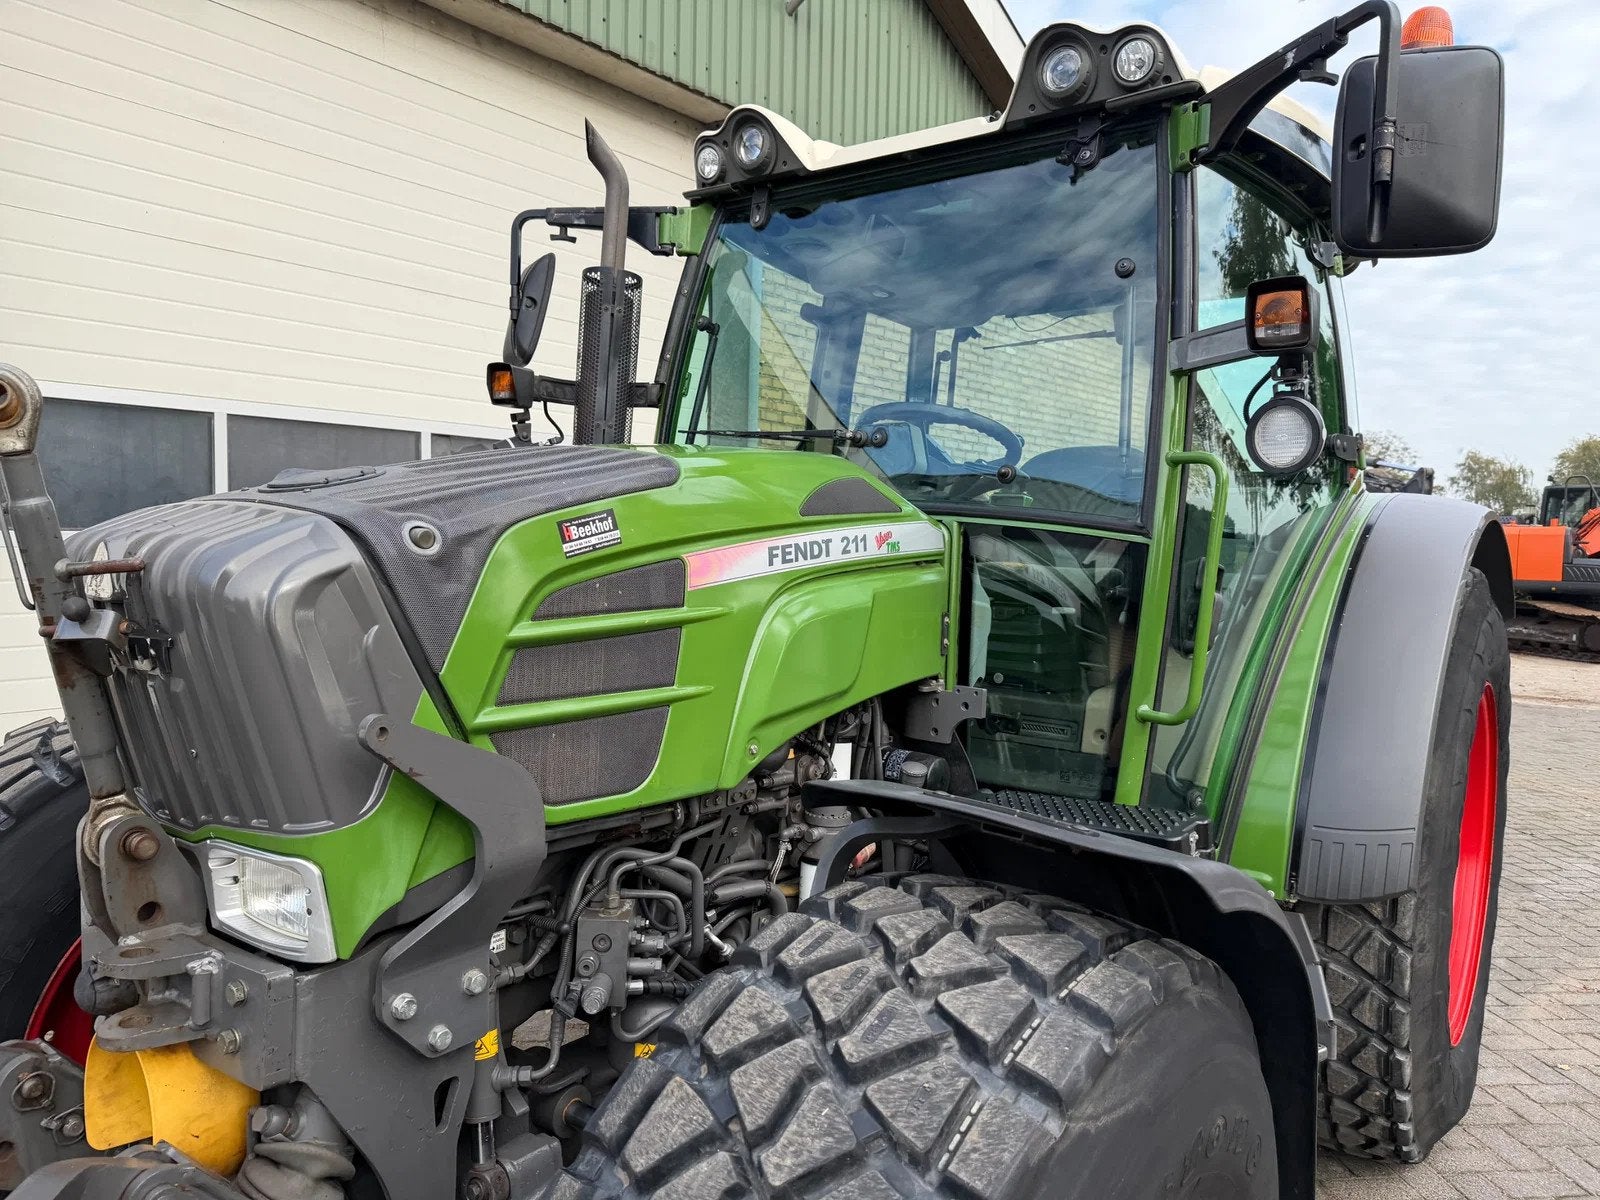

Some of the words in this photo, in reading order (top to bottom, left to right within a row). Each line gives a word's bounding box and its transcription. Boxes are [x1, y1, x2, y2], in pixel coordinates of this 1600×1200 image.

[767, 538, 833, 567] FENDT
[840, 533, 868, 556] 211
[886, 541, 901, 554] TMS
